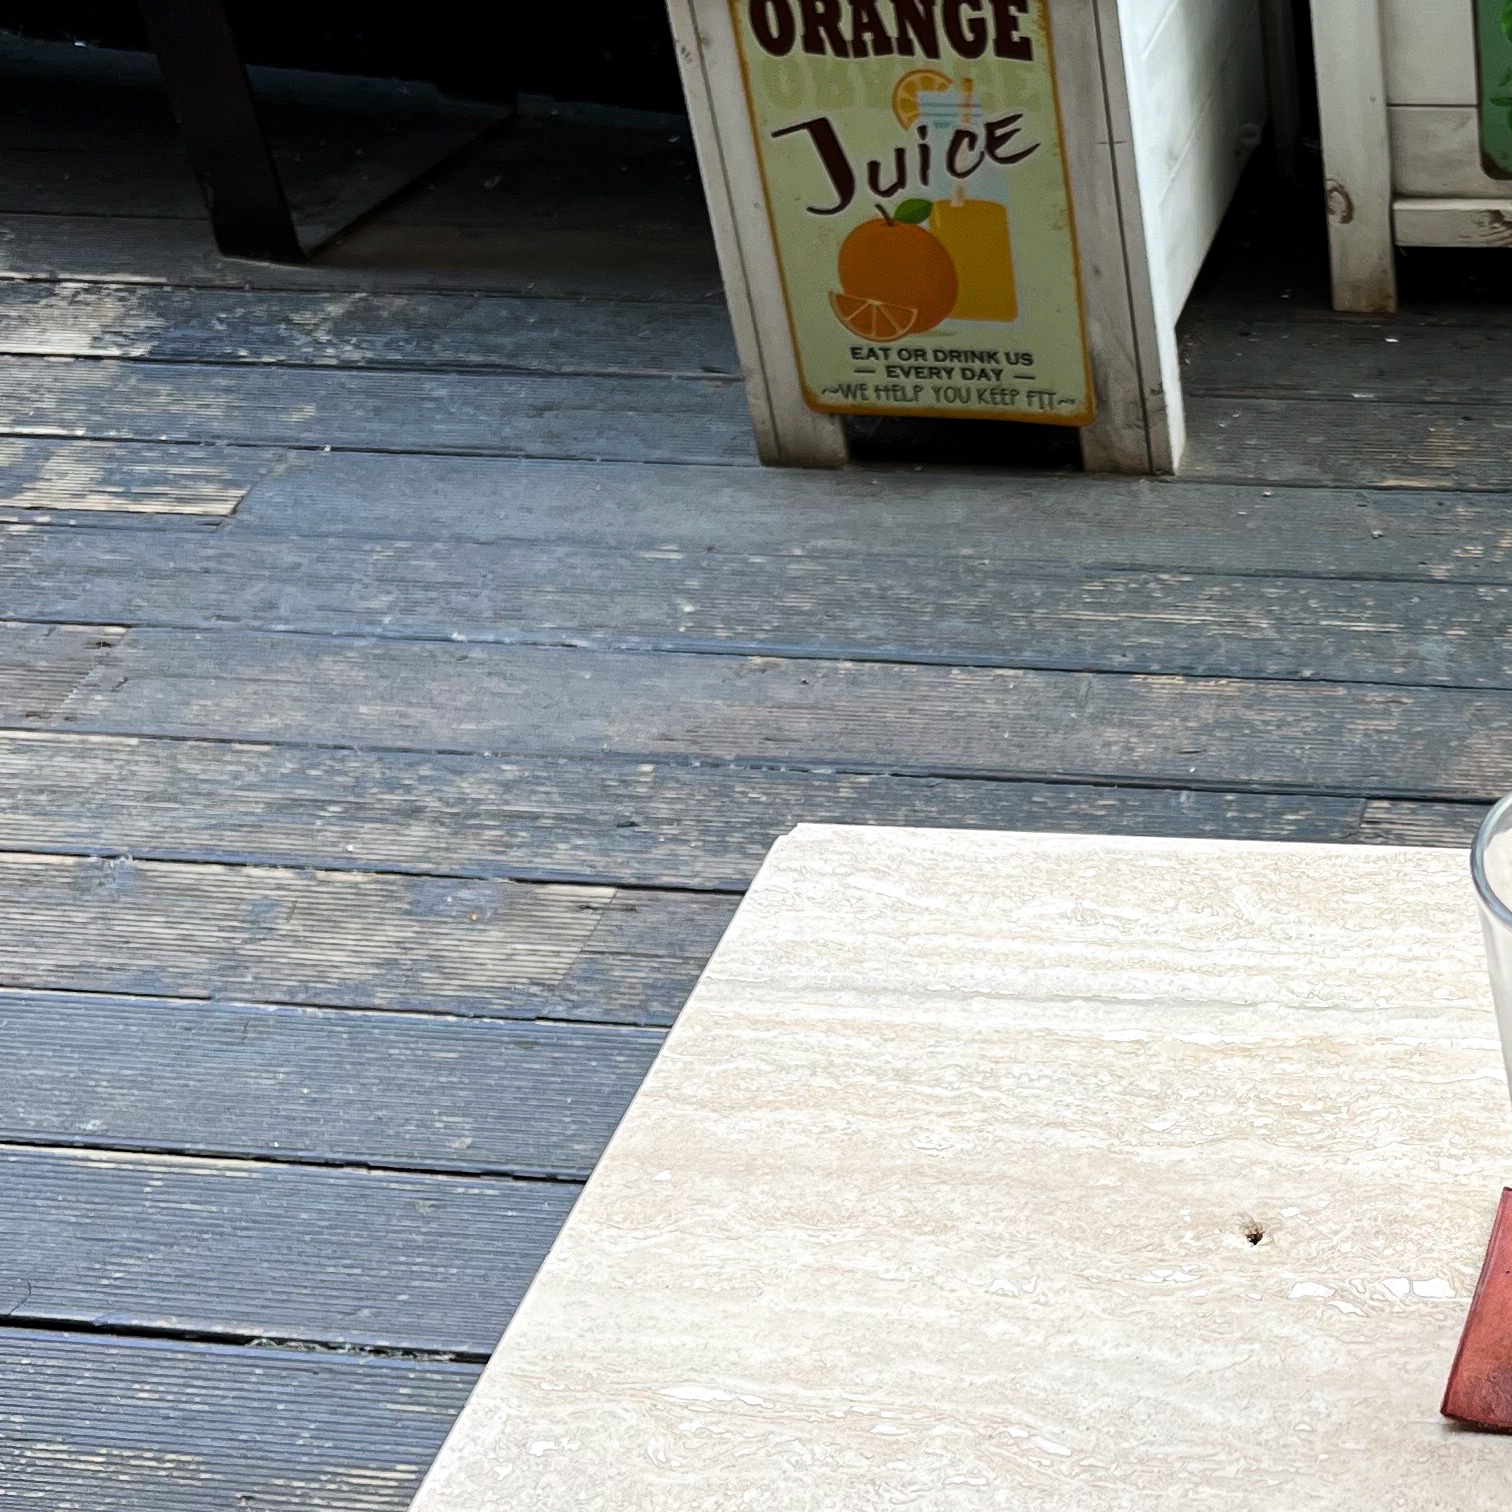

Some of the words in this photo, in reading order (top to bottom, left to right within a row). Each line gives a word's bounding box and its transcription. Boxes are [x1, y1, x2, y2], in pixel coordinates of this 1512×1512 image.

[750, 0, 1033, 61] ORANGE
[851, 347, 891, 361] EAT
[897, 348, 928, 362] OR
[933, 350, 999, 364] DRINK
[1006, 352, 1034, 366] US
[885, 365, 955, 379] EVERY
[962, 367, 1003, 381] DAY
[875, 384, 923, 402] HELP
[932, 386, 971, 404] YOU
[977, 388, 1019, 406] KEEP
